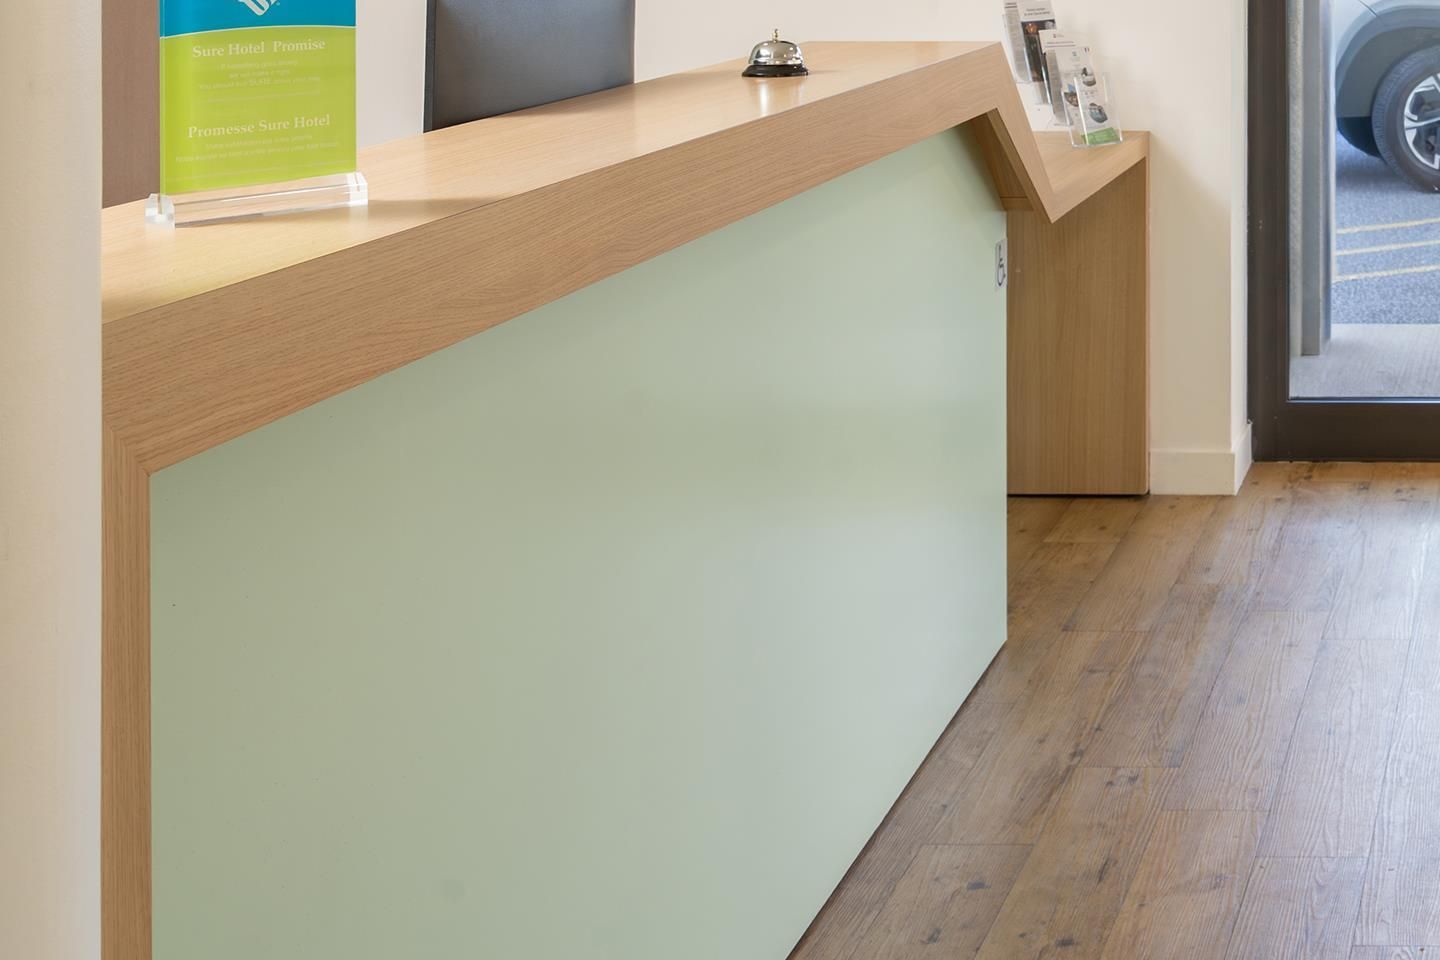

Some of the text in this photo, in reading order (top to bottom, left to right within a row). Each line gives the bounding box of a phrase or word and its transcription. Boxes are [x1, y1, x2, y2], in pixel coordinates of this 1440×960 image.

[192, 38, 326, 59] Sure Hotel Promise
[187, 113, 331, 139] Promesse Sure Hotel
